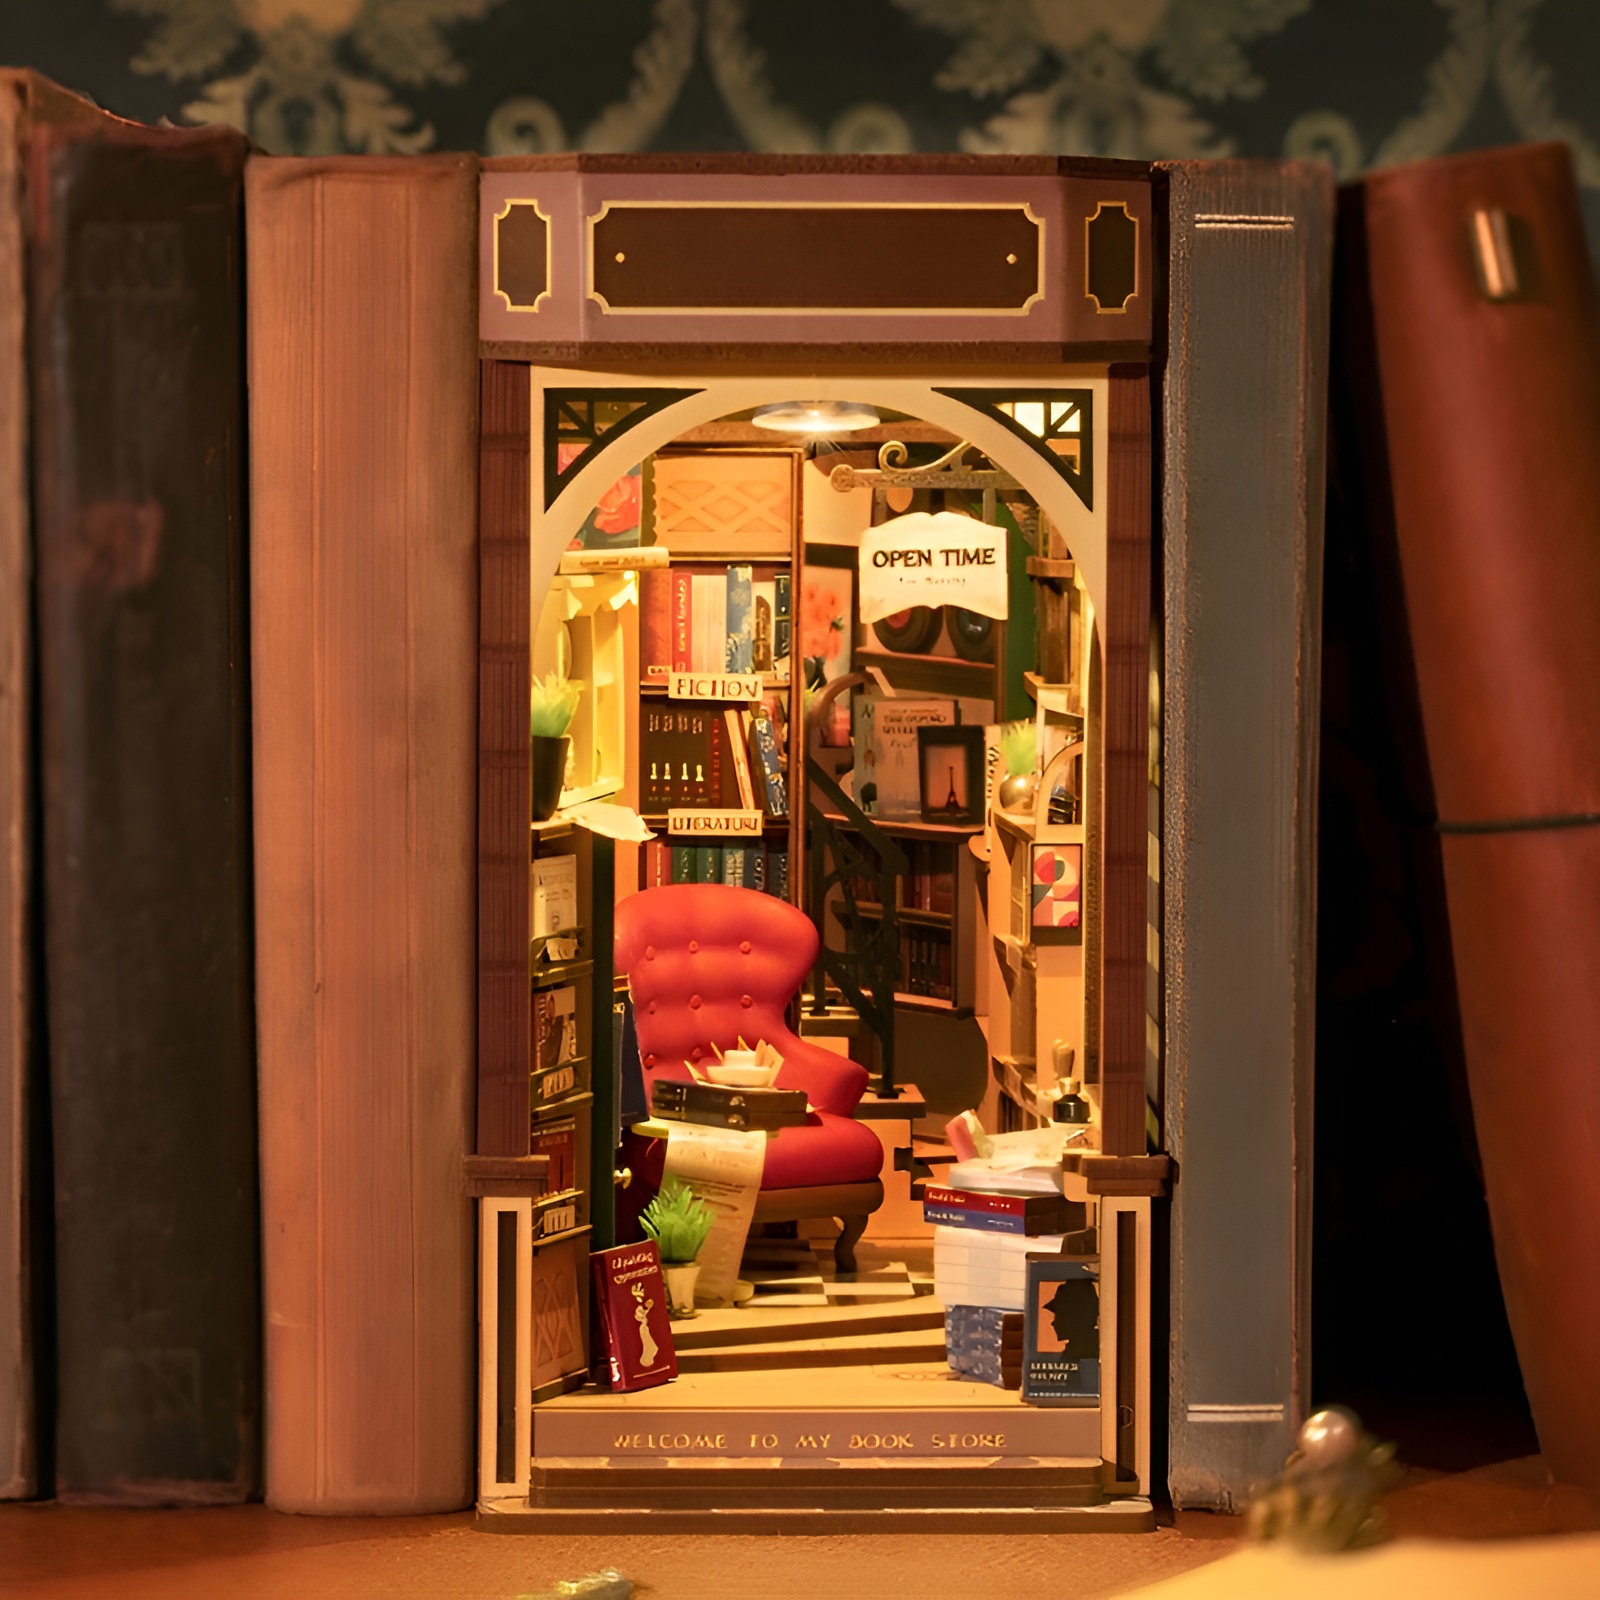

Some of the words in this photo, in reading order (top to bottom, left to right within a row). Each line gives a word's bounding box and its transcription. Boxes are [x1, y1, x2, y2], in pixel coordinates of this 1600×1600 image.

[872, 549, 932, 568] OPEN
[939, 547, 996, 567] TIME
[613, 1433, 728, 1449] WELCOME
[750, 1434, 778, 1449] TO
[795, 1433, 831, 1449] MY
[848, 1433, 914, 1449] BOOK
[931, 1434, 1008, 1449] STORE
